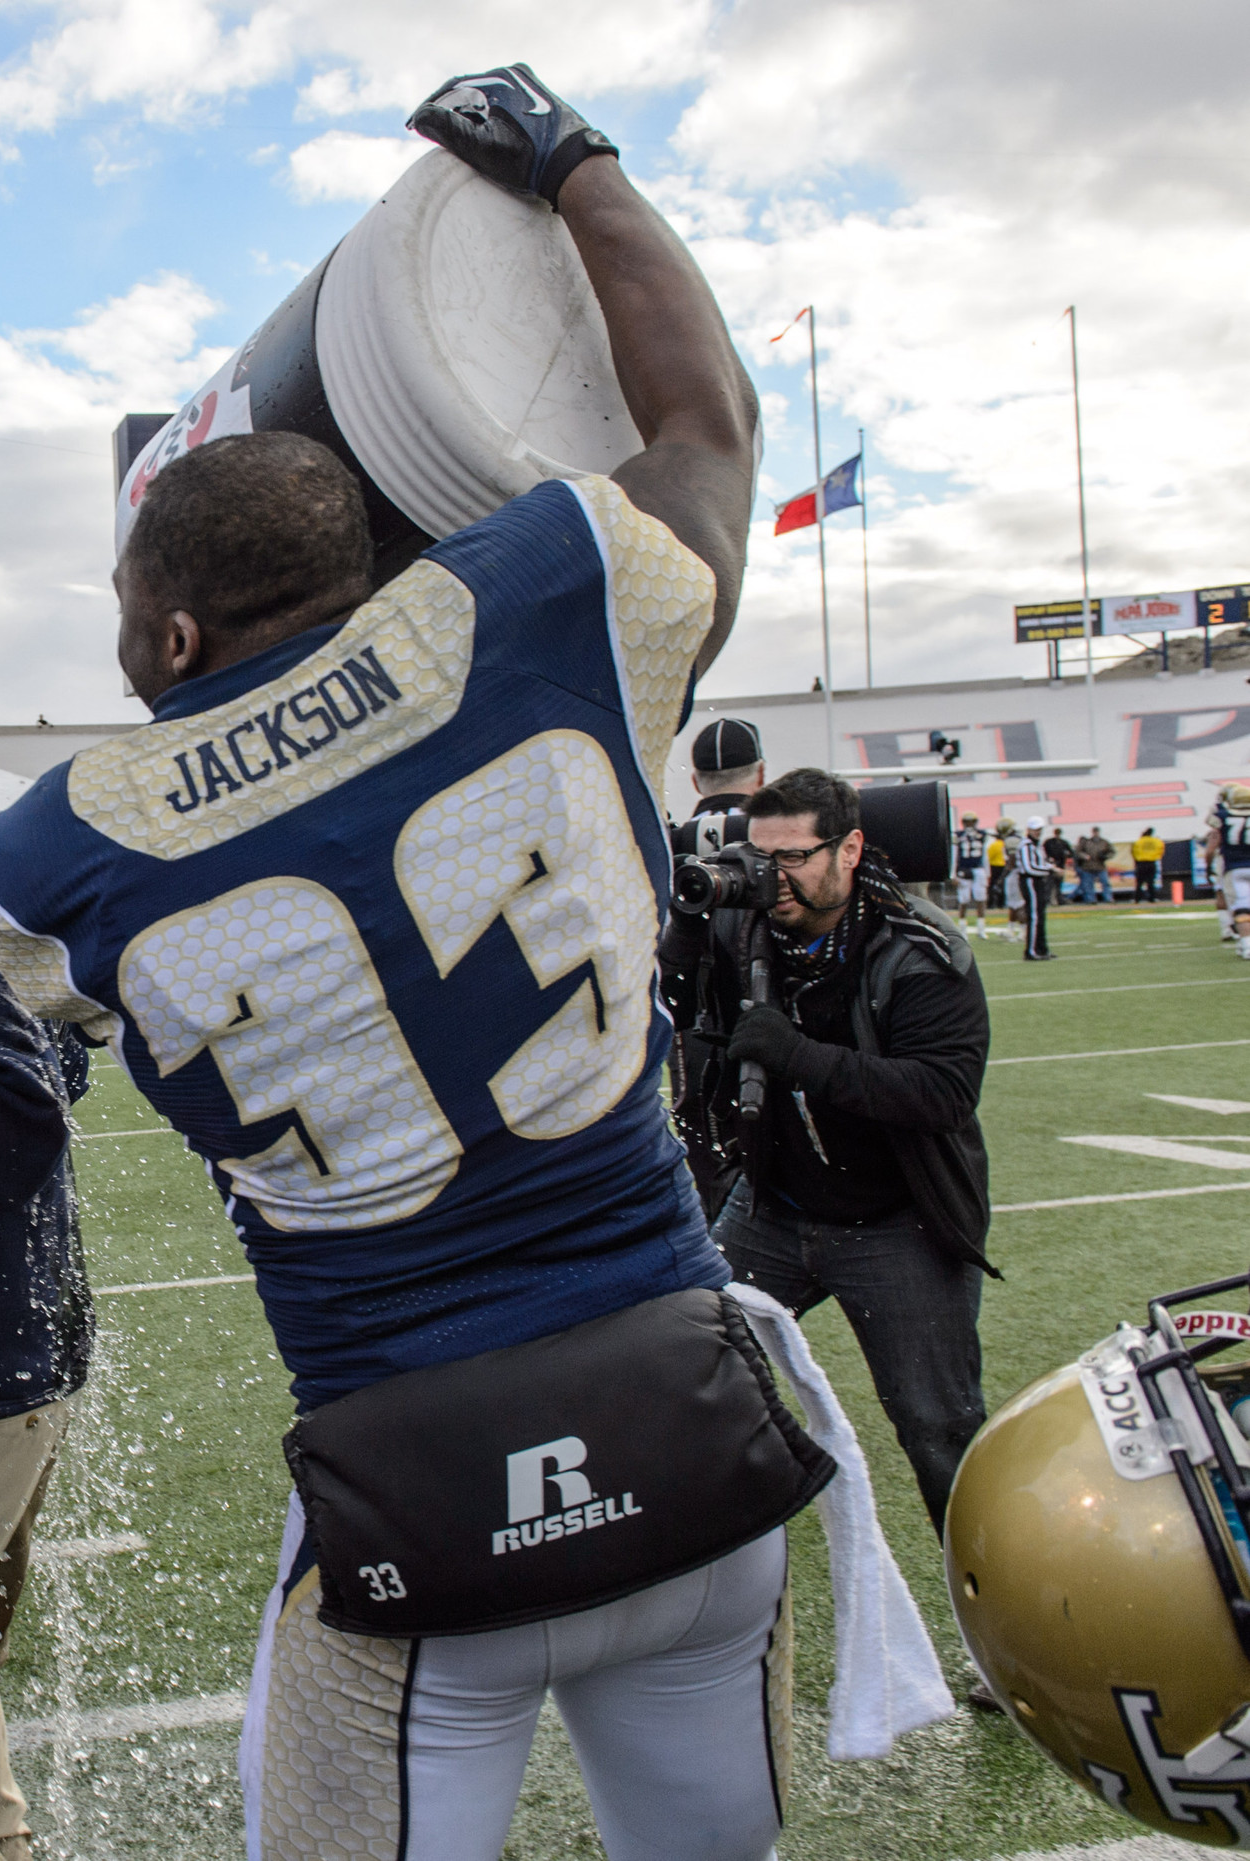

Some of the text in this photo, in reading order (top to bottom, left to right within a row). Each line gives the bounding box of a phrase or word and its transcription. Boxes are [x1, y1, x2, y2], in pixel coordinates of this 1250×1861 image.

[1207, 603, 1225, 624] 2
[165, 645, 402, 816] JACKSON
[117, 728, 660, 1232] 33
[1100, 1381, 1141, 1432] ACC
[491, 1491, 643, 1556] RUSSELL
[358, 1561, 408, 1602] 33
